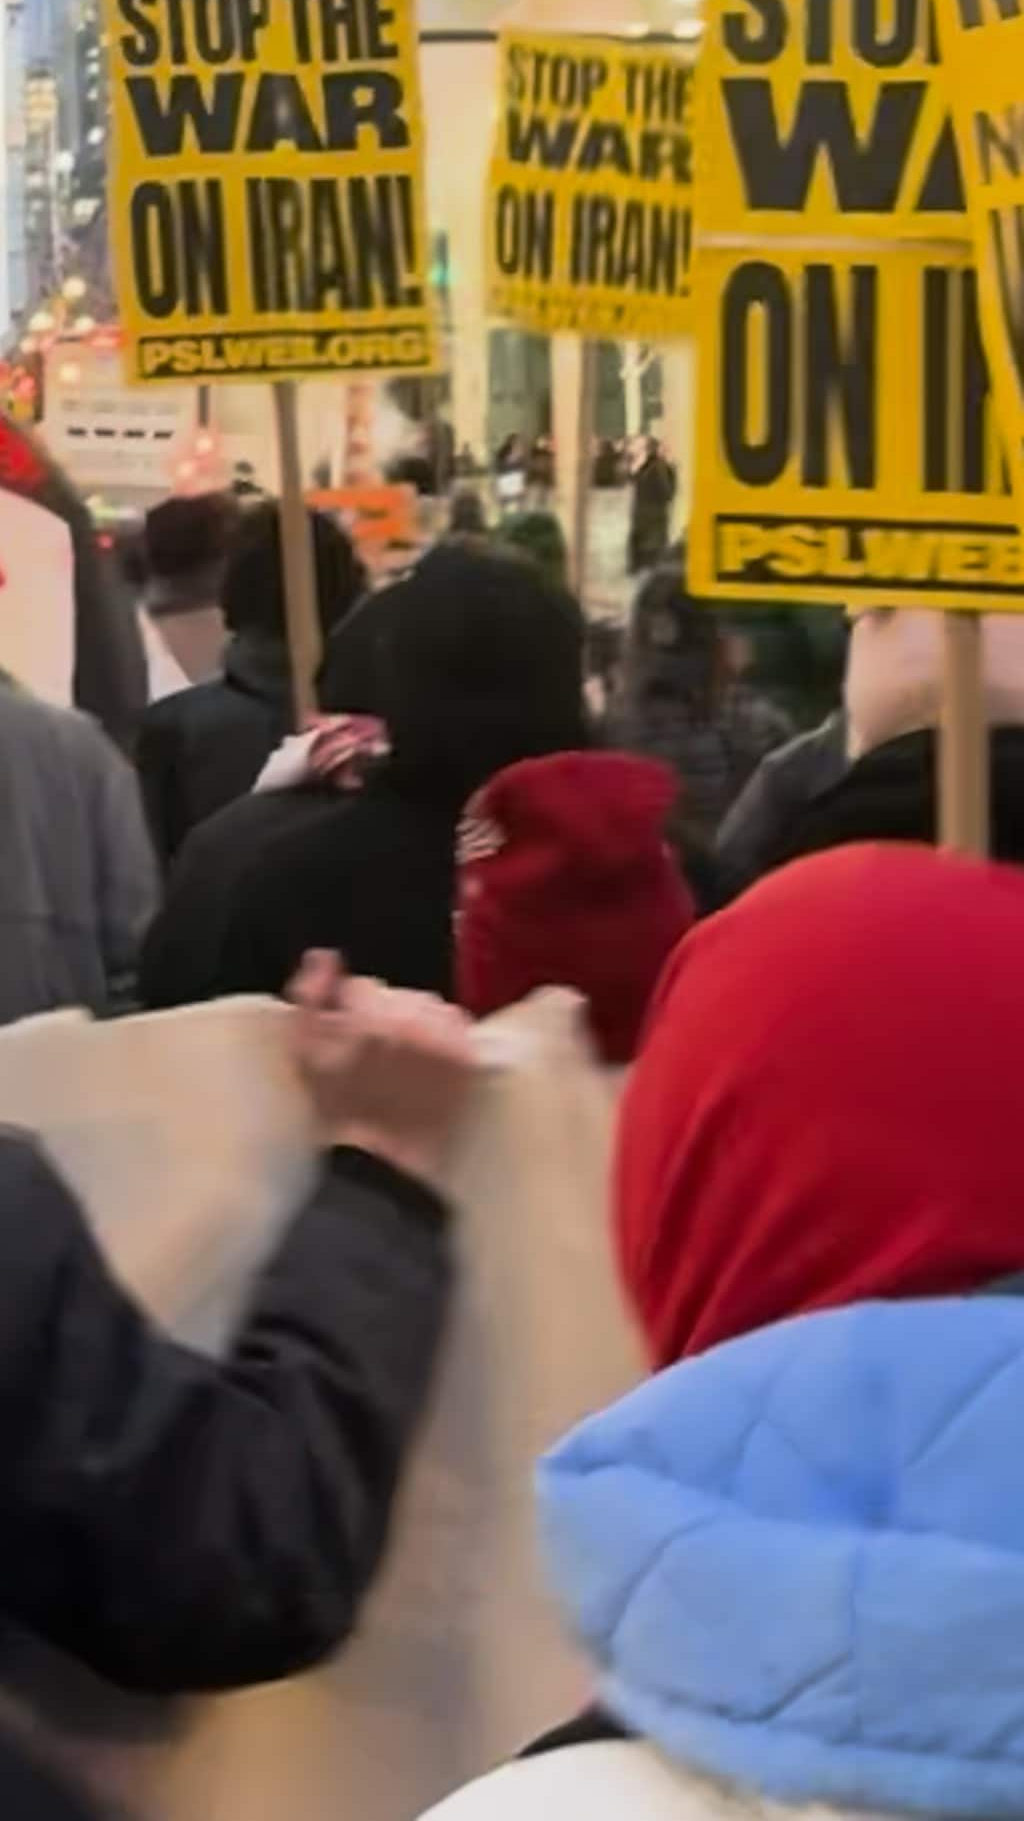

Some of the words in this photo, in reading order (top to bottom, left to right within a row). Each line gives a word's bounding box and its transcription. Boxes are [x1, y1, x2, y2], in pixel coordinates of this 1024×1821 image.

[124, 71, 411, 157] WAR
[508, 44, 607, 109] STOP
[624, 64, 695, 124] THE
[506, 109, 693, 184] WAR
[131, 178, 229, 318] ON
[246, 175, 423, 313] IRAN!
[496, 184, 554, 286] ON
[571, 191, 692, 298] IRAN!
[721, 261, 877, 489] ON
